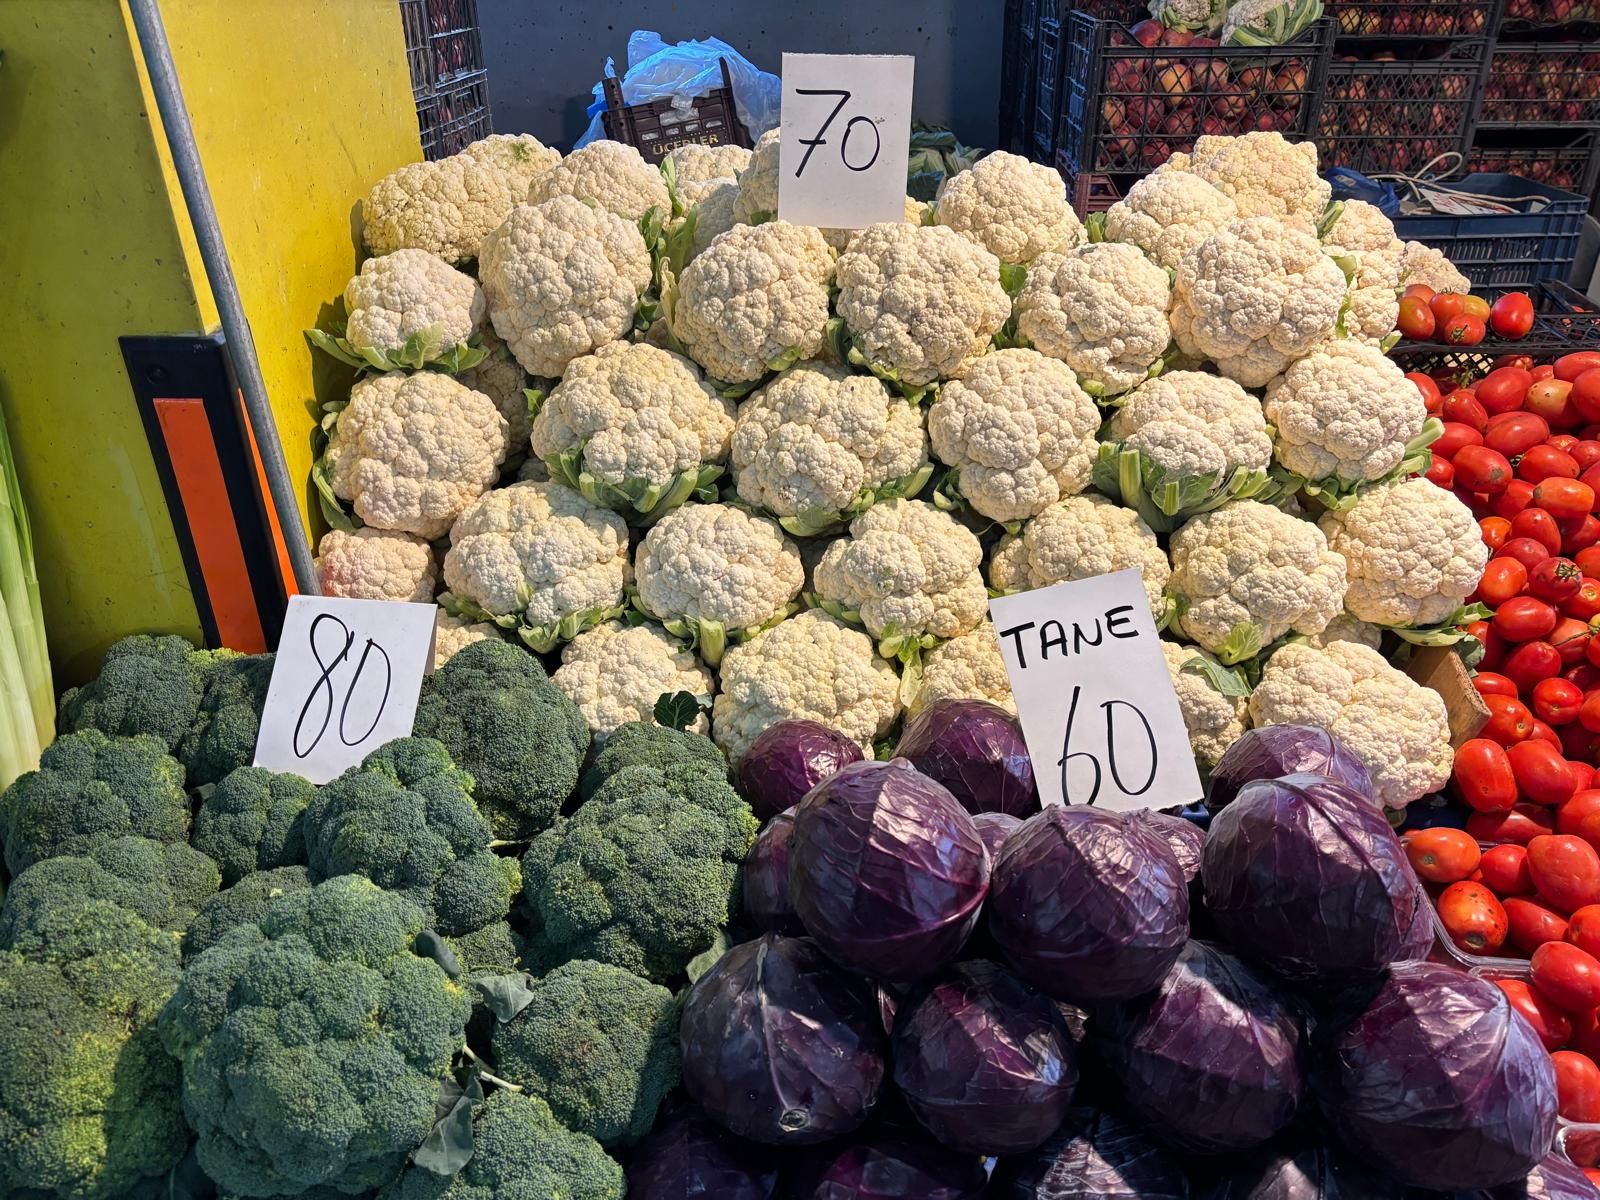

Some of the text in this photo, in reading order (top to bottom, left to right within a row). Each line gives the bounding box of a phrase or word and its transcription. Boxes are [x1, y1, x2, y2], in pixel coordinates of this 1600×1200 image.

[795, 88, 880, 178] 70
[293, 613, 391, 758] 80
[1000, 605, 1139, 669] TANE
[1058, 686, 1158, 806] 60
